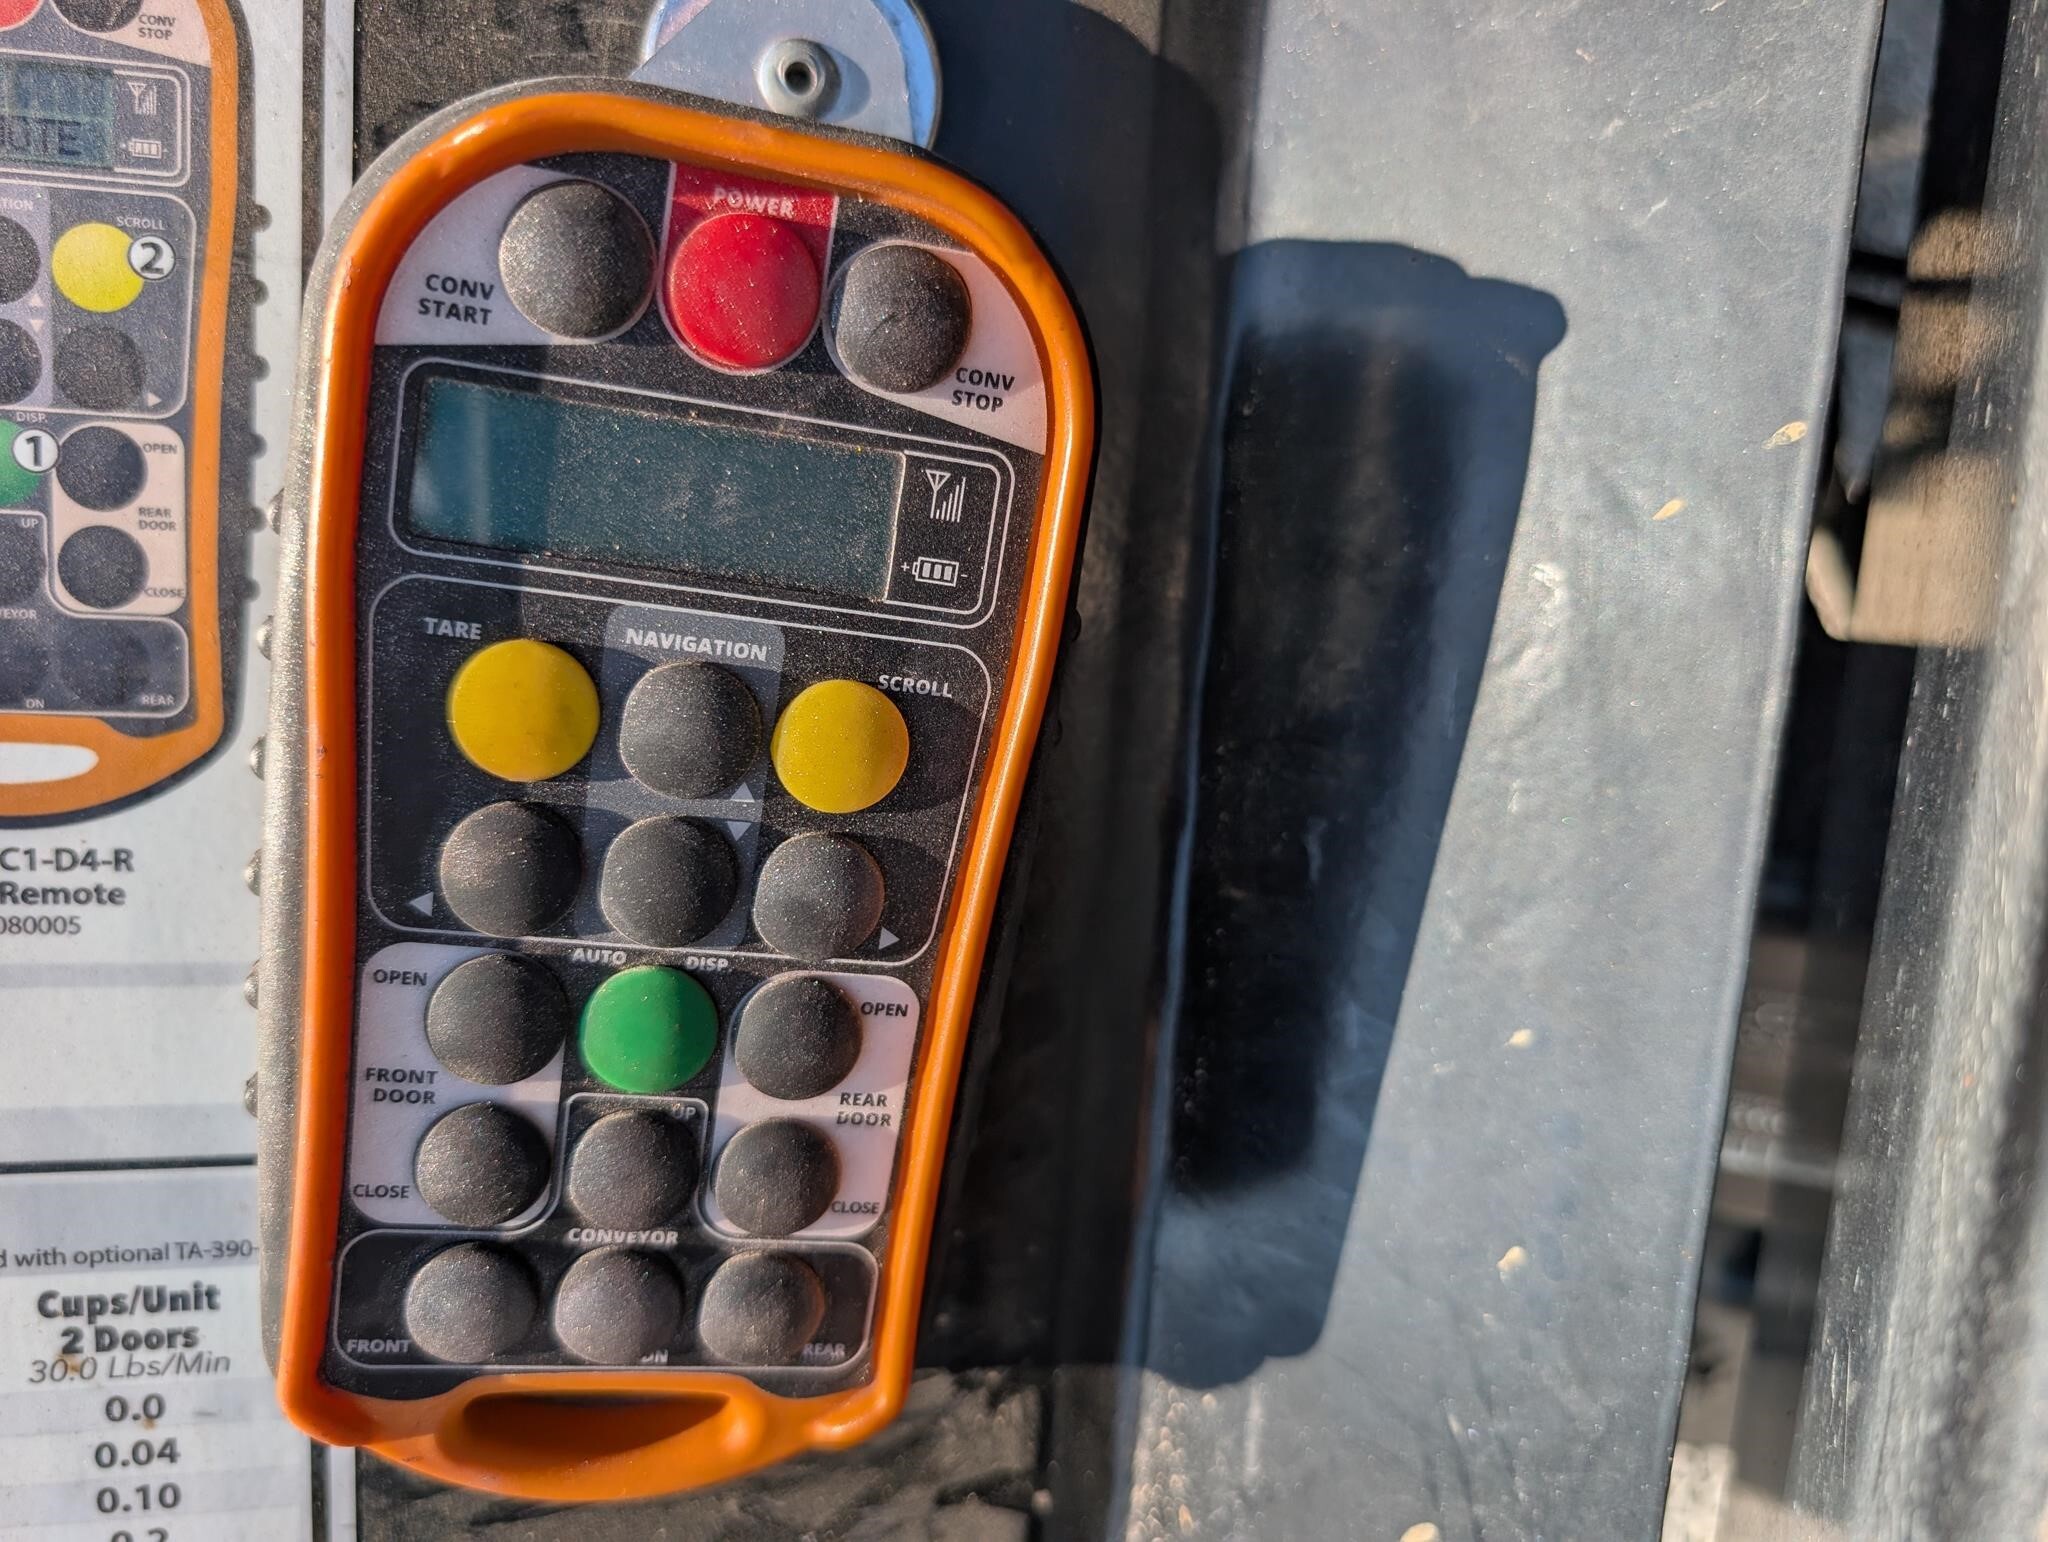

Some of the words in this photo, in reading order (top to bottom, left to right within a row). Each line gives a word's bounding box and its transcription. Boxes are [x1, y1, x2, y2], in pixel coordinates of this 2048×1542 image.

[138, 14, 177, 28] CONV
[138, 26, 173, 41] STOP
[713, 186, 795, 221] POWER
[116, 215, 166, 231] SCROLL
[140, 242, 165, 275] 2
[425, 273, 495, 300] CONV
[418, 297, 492, 326] START
[956, 366, 1016, 392] CONV
[952, 388, 1004, 413] STOP
[26, 435, 42, 467] 1
[143, 443, 178, 455] OPEN
[21, 517, 39, 530] UP
[139, 507, 172, 519] REAR
[139, 519, 177, 532] DOOR
[144, 587, 185, 599] CLOSE
[0, 607, 37, 620] EYOR
[424, 617, 482, 640] TARE
[626, 627, 769, 662] NAVIGATION
[878, 674, 954, 699] SCROLL
[142, 694, 175, 707] REAR
[0, 847, 135, 873] C1-D4-R
[0, 880, 127, 906] Remote
[572, 947, 628, 966] AUTO
[372, 968, 427, 988] OPEN
[860, 1000, 909, 1018] OPEN
[364, 1066, 438, 1087] FRONT
[372, 1087, 437, 1106] DOOR
[838, 1091, 888, 1109] REAR
[836, 1109, 893, 1128] DOOR
[352, 1183, 411, 1201] CLOSE
[831, 1200, 880, 1215] CLOSE
[568, 1225, 680, 1247] CONVEYOR
[13, 1246, 67, 1267] with
[73, 1241, 170, 1269] optional
[37, 1280, 222, 1325] Cups/Unit
[60, 1325, 85, 1355] 2
[94, 1325, 201, 1353] Doors
[347, 1338, 411, 1354] FRONT
[802, 1342, 846, 1357] REAR
[29, 1356, 98, 1384] 30.0
[108, 1350, 231, 1379] Lbs/Min
[105, 1393, 166, 1422] 0.0
[94, 1437, 182, 1468] 0.04
[96, 1482, 182, 1514] 0.10
